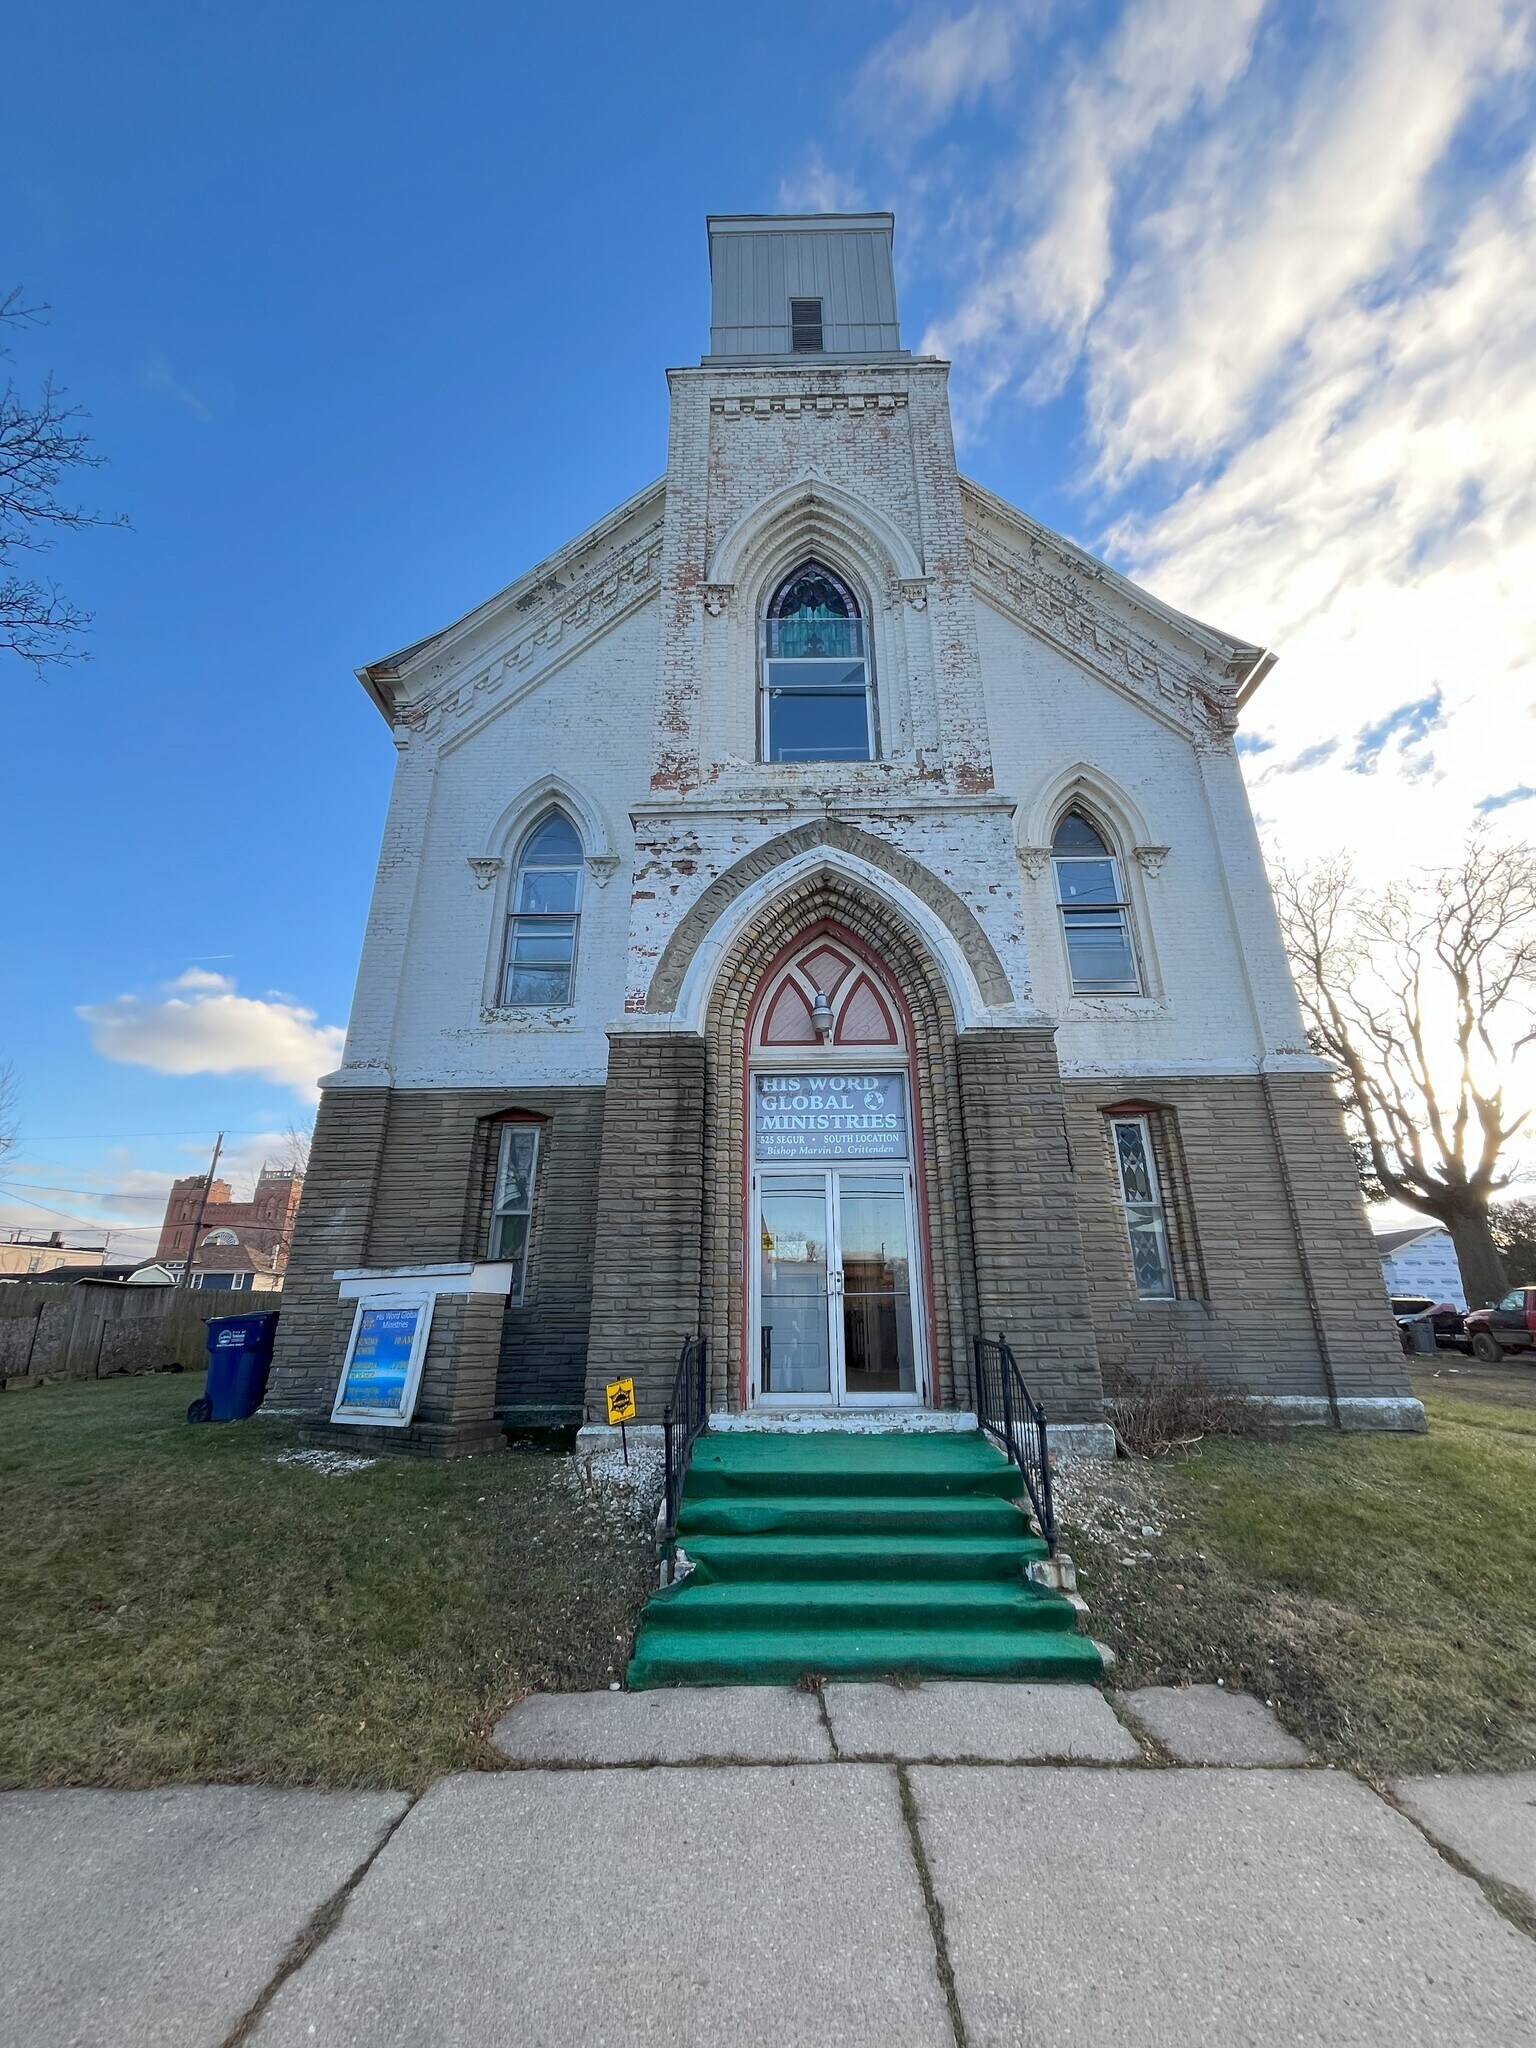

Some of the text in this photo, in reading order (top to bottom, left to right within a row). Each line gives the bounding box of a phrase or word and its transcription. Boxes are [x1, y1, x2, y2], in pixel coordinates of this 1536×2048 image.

[762, 1076, 879, 1092] HIS WORD
[762, 1095, 854, 1111] GLOBAL
[761, 1113, 898, 1130] MINISTRIES
[760, 1133, 900, 1145] 525 SEGUR SOUTH LOCATION
[767, 1145, 894, 1157] Bishop Marvin D. Crittenden
[376, 1310, 418, 1321] His Word Globa
[382, 1320, 409, 1329] Ministries
